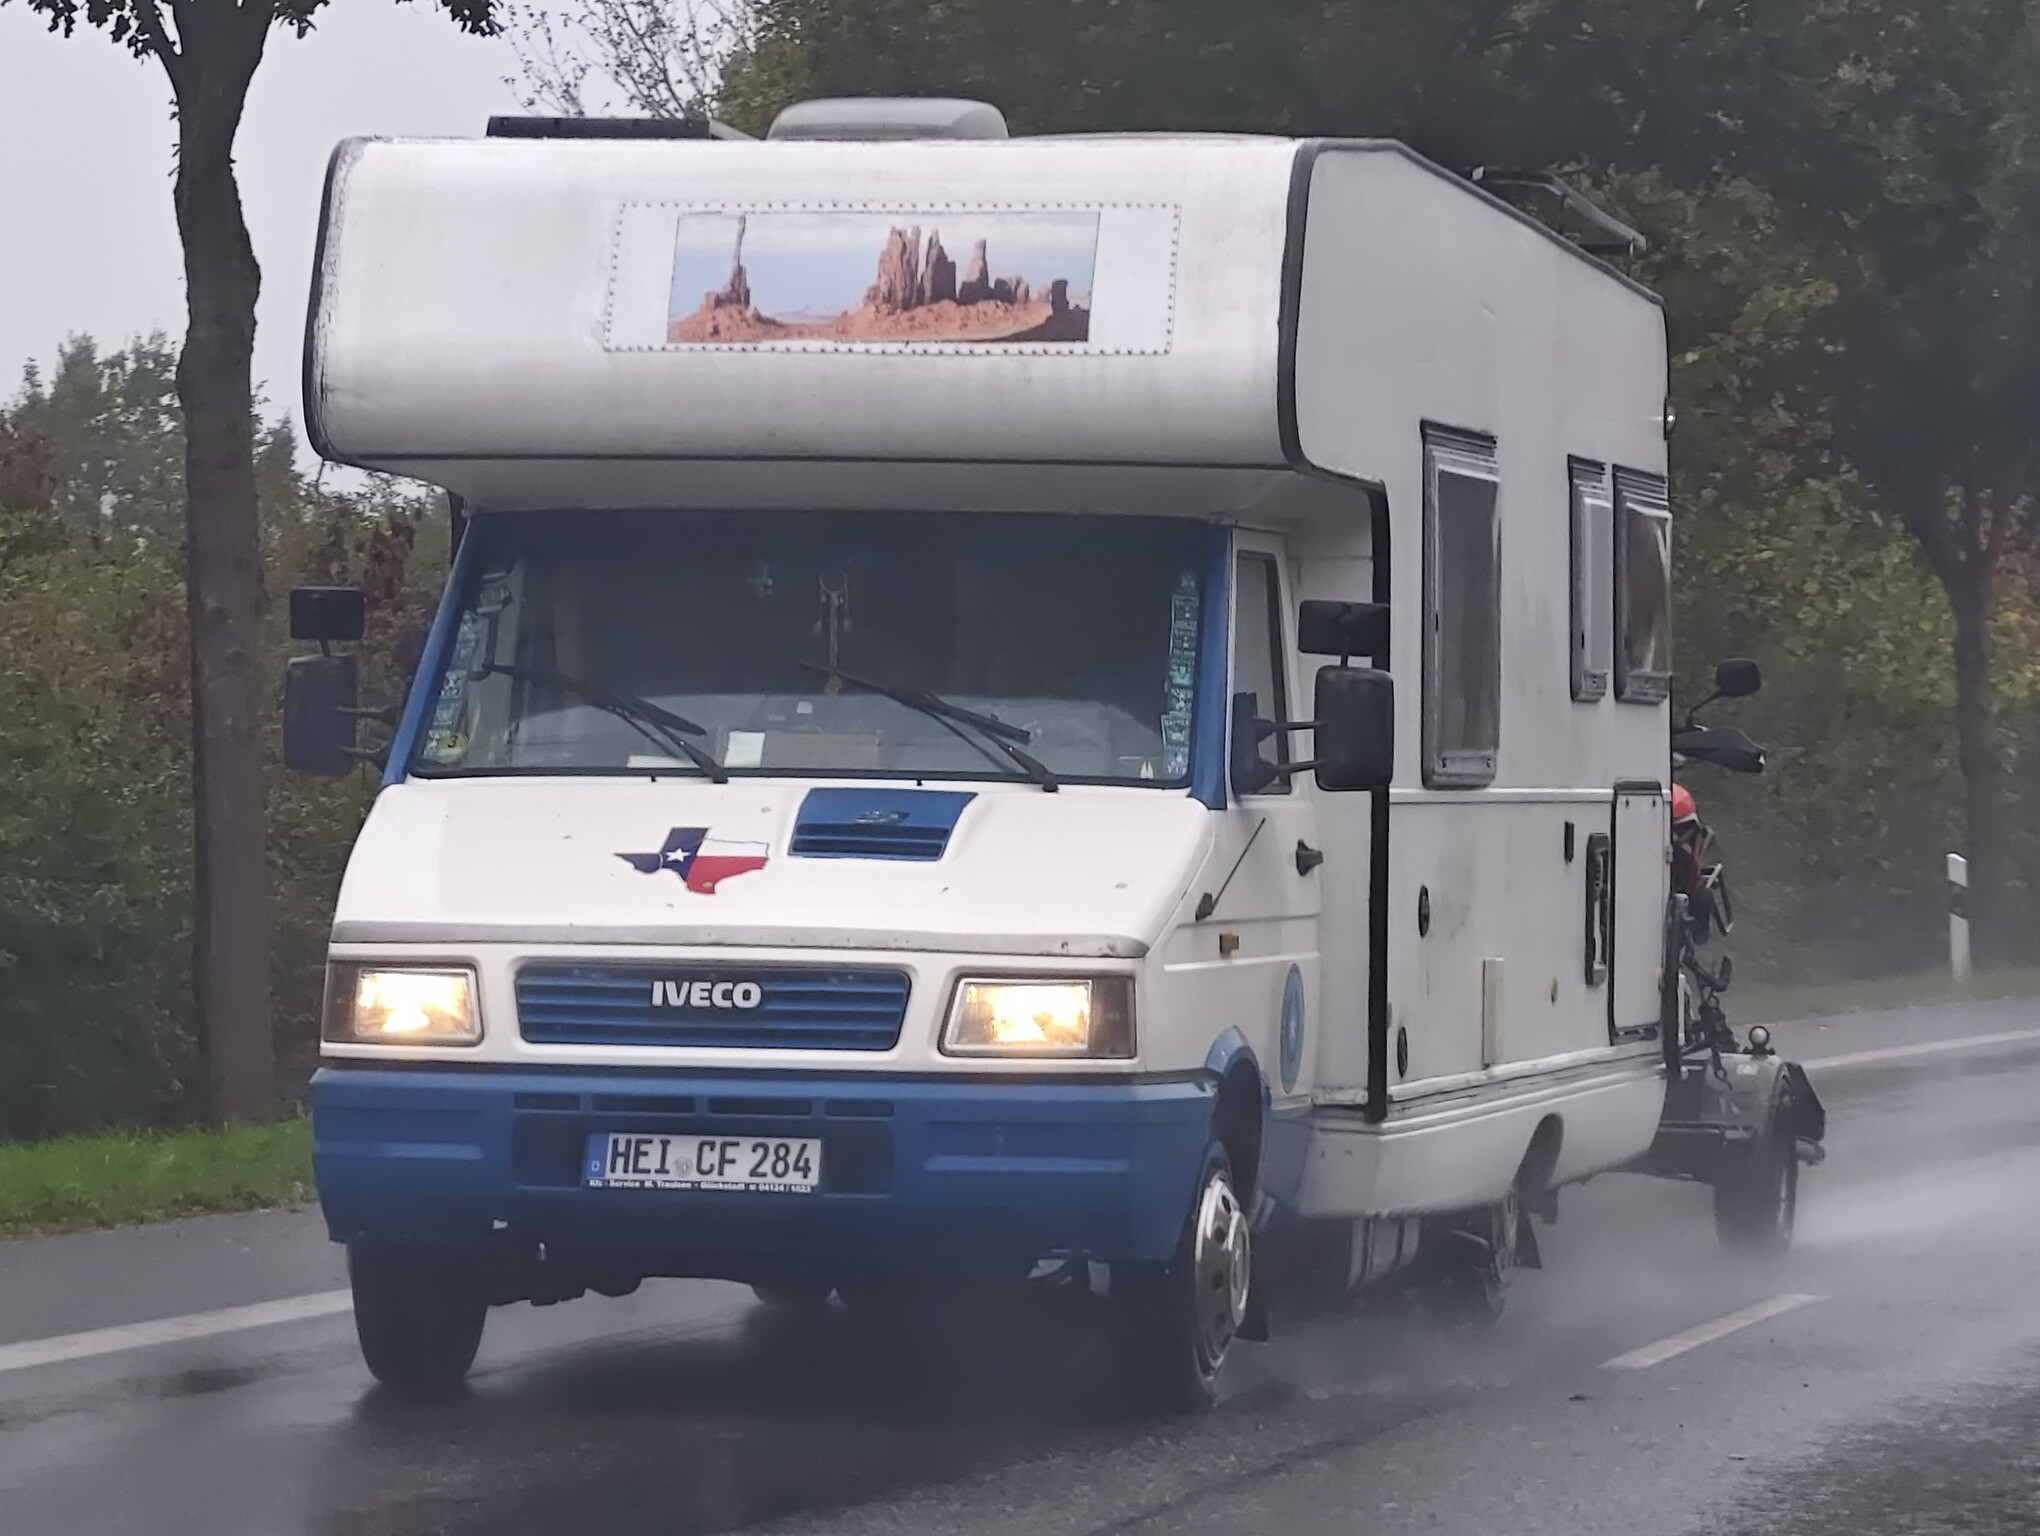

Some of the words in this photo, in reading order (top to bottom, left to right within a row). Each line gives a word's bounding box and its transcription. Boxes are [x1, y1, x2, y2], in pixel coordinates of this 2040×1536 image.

[652, 981, 761, 1008] IVECO
[591, 1160, 600, 1172] D
[609, 1137, 671, 1174] HEI
[696, 1140, 740, 1176] CF
[749, 1142, 811, 1179] 284
